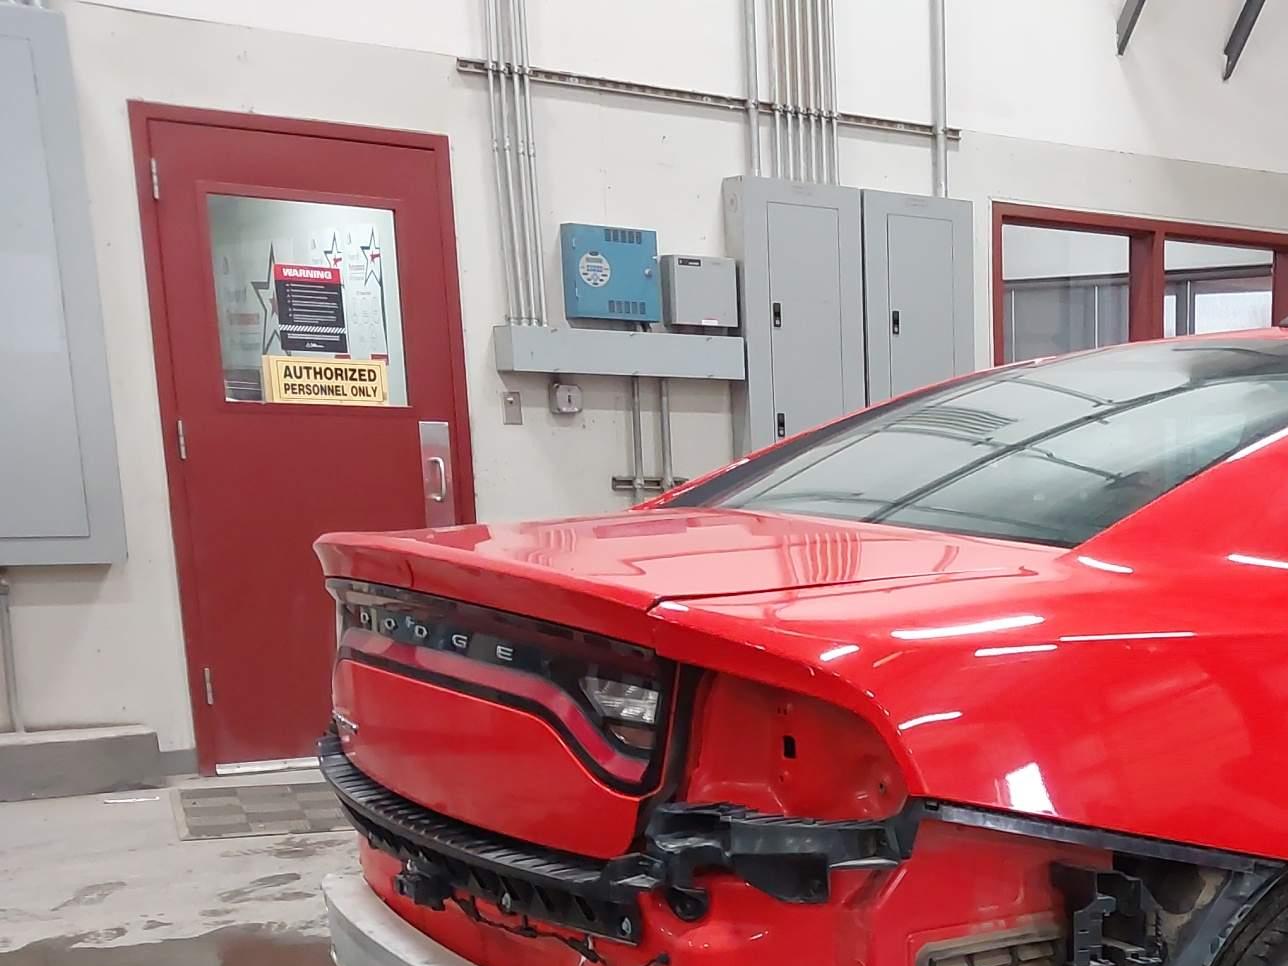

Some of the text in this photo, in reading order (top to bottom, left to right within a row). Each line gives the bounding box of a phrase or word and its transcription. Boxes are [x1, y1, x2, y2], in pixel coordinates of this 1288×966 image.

[282, 268, 333, 280] WARNING
[283, 365, 377, 382] AUTHORIZED
[284, 383, 378, 398] PERSONNEL ONLY
[360, 610, 514, 661] DODGE
